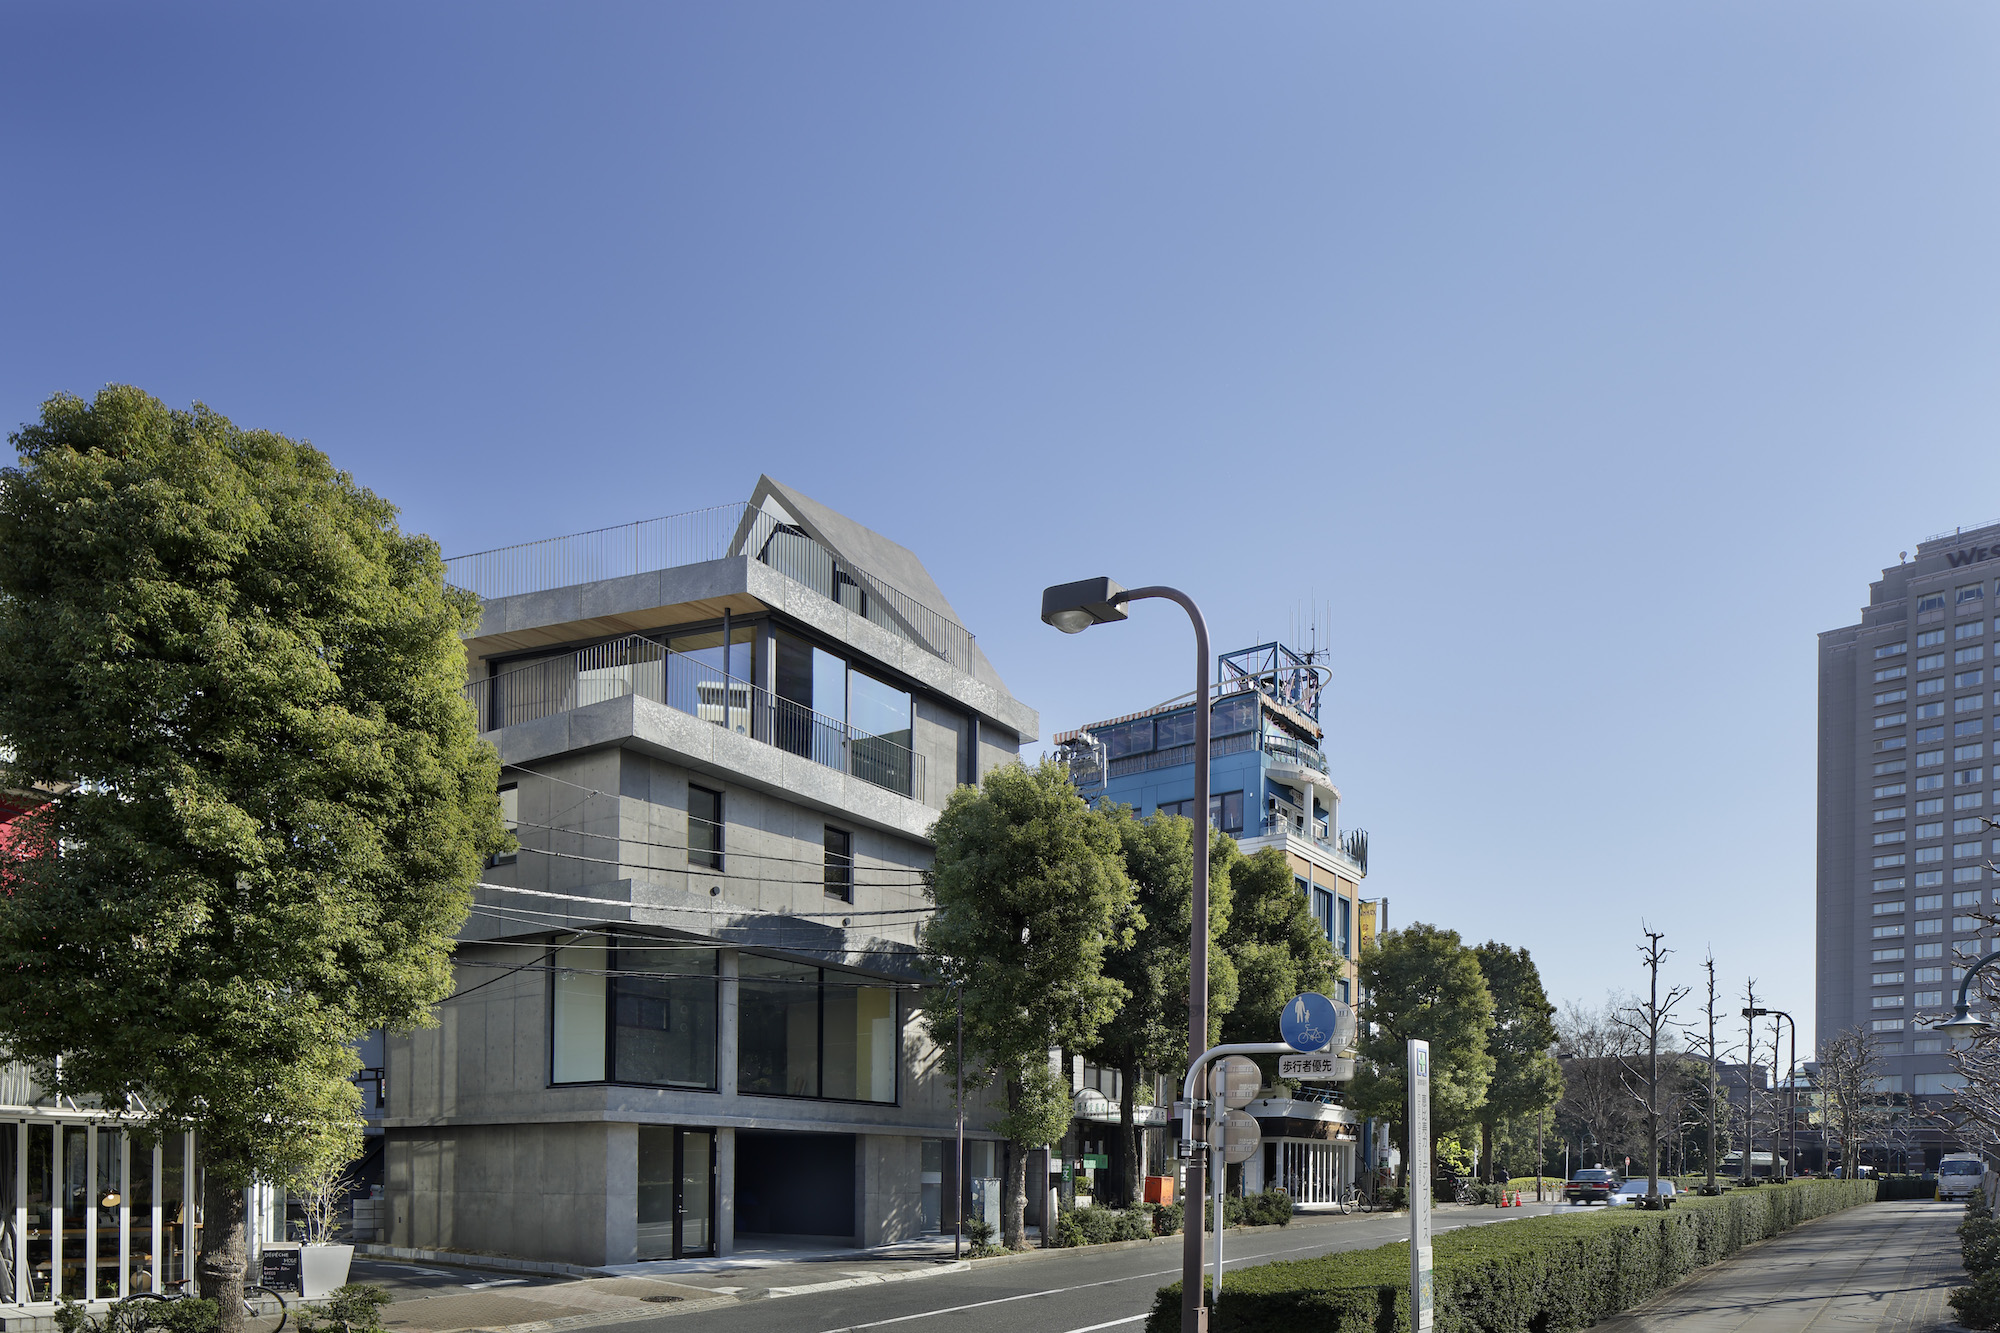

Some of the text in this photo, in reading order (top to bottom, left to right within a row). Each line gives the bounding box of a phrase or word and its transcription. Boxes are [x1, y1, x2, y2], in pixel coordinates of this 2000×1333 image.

[1283, 1059, 1332, 1073] 歩行者優先
